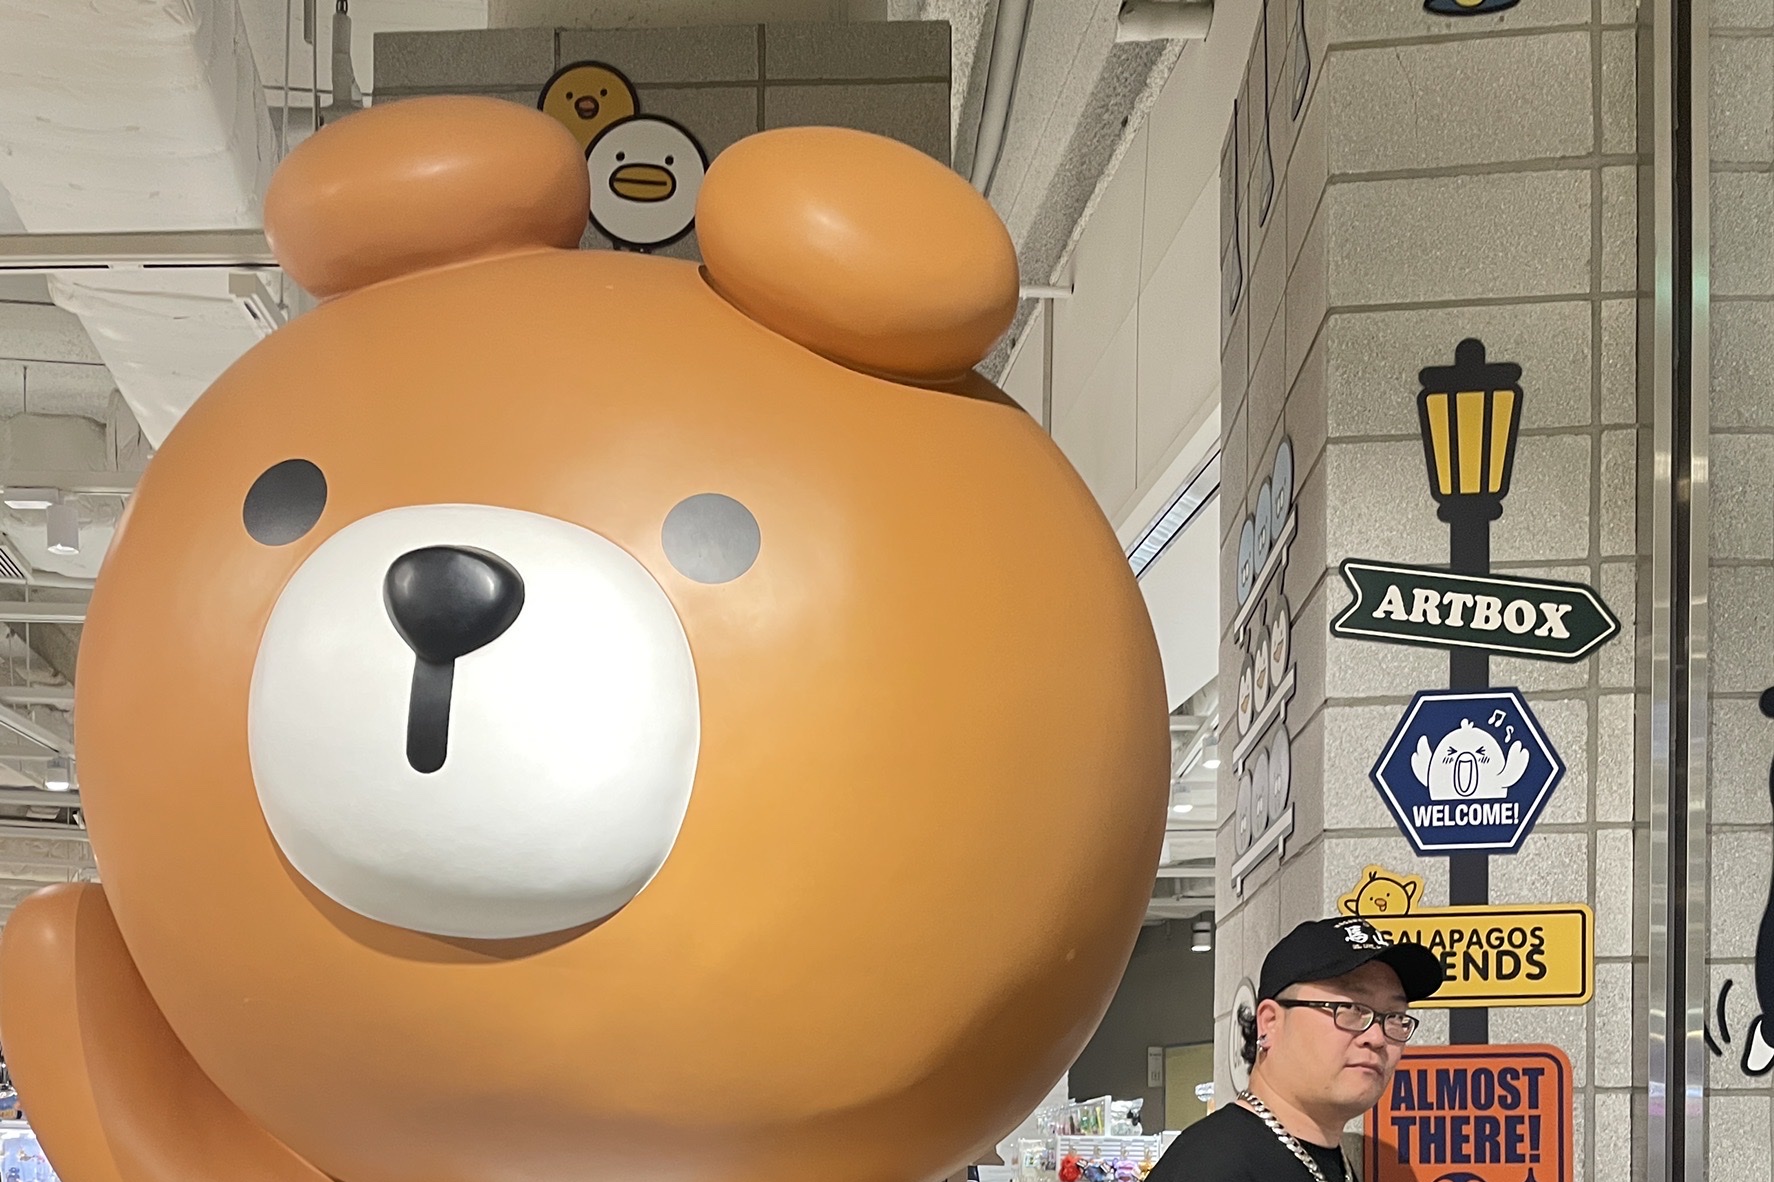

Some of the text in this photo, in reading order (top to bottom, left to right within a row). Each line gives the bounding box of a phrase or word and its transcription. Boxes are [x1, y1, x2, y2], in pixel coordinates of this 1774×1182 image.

[1372, 584, 1573, 640] ARTBOX
[1412, 802, 1520, 828] WELCOME!
[1440, 949, 1548, 982] ENDS
[1390, 1066, 1546, 1112] ALMOST
[1390, 1114, 1542, 1165] THERE!
